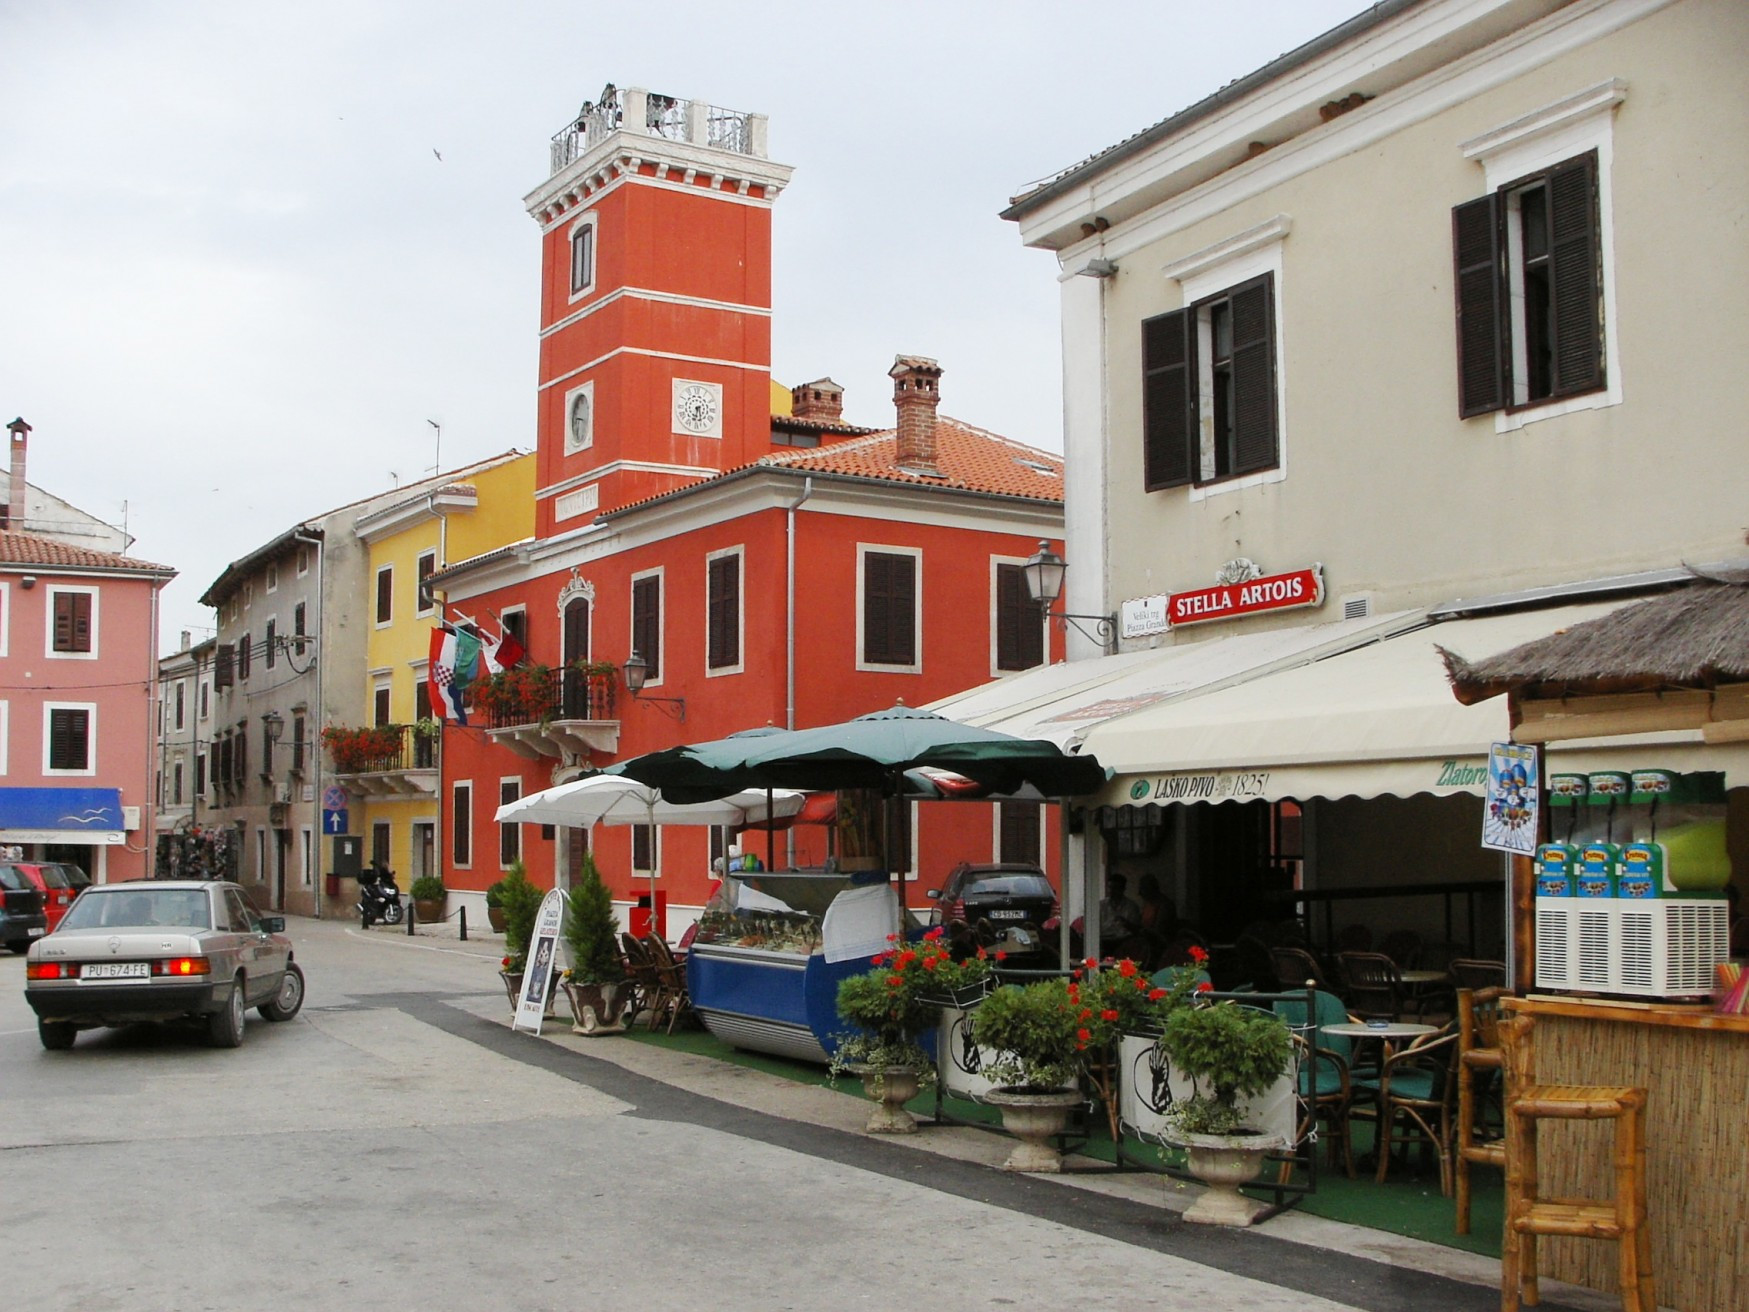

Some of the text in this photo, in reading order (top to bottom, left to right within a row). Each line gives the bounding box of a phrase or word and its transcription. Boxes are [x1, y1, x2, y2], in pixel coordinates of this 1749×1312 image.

[1176, 577, 1303, 617] STELLA ARTOIS
[1154, 773, 1270, 799] LAŠKO PIVO 1825!
[1435, 760, 1488, 788] Zlatoro
[89, 965, 103, 976] PU
